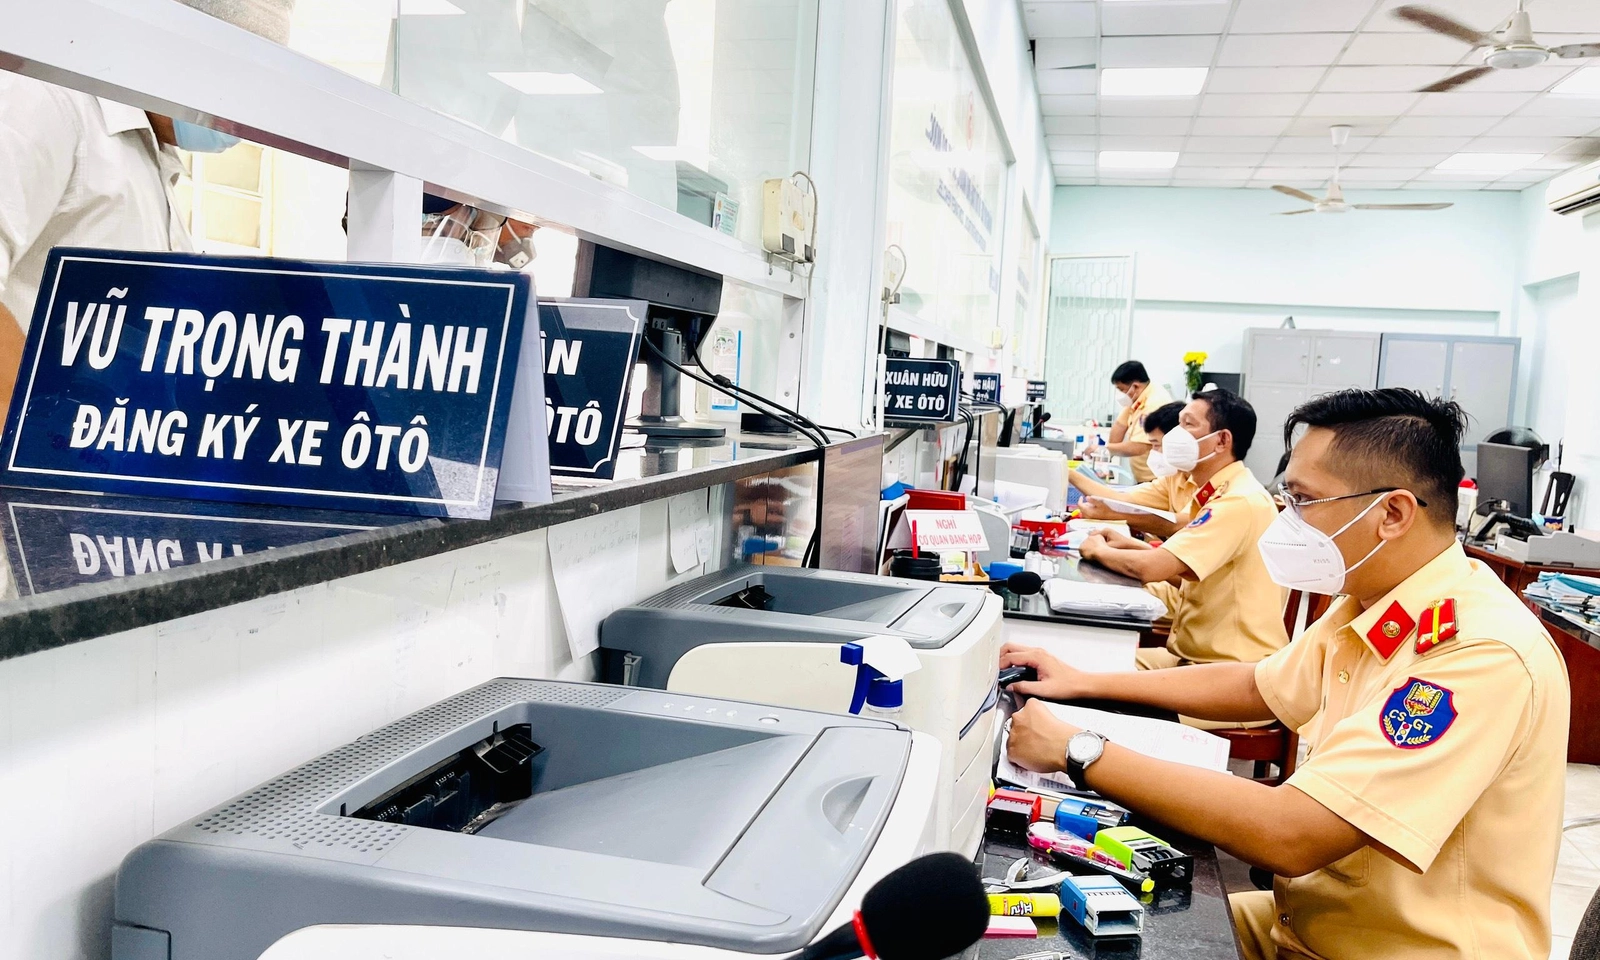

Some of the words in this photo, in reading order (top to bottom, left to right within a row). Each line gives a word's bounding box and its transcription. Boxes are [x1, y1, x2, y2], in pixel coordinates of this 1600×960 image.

[60, 286, 129, 371] VŨ
[140, 305, 305, 392] TRỌNG
[318, 304, 489, 394] THÀNH
[885, 369, 920, 386] XUÂN
[922, 371, 949, 388] HỮU
[884, 391, 893, 408] Ý
[894, 395, 914, 409] XE
[917, 393, 946, 411] ÔTÔ
[70, 398, 189, 456] ĐĂNG
[197, 403, 260, 461] KÝ
[268, 417, 329, 466] XE
[341, 411, 430, 473] ÔTÔ
[929, 534, 948, 547] QUAN
[948, 534, 968, 545] ĐANG
